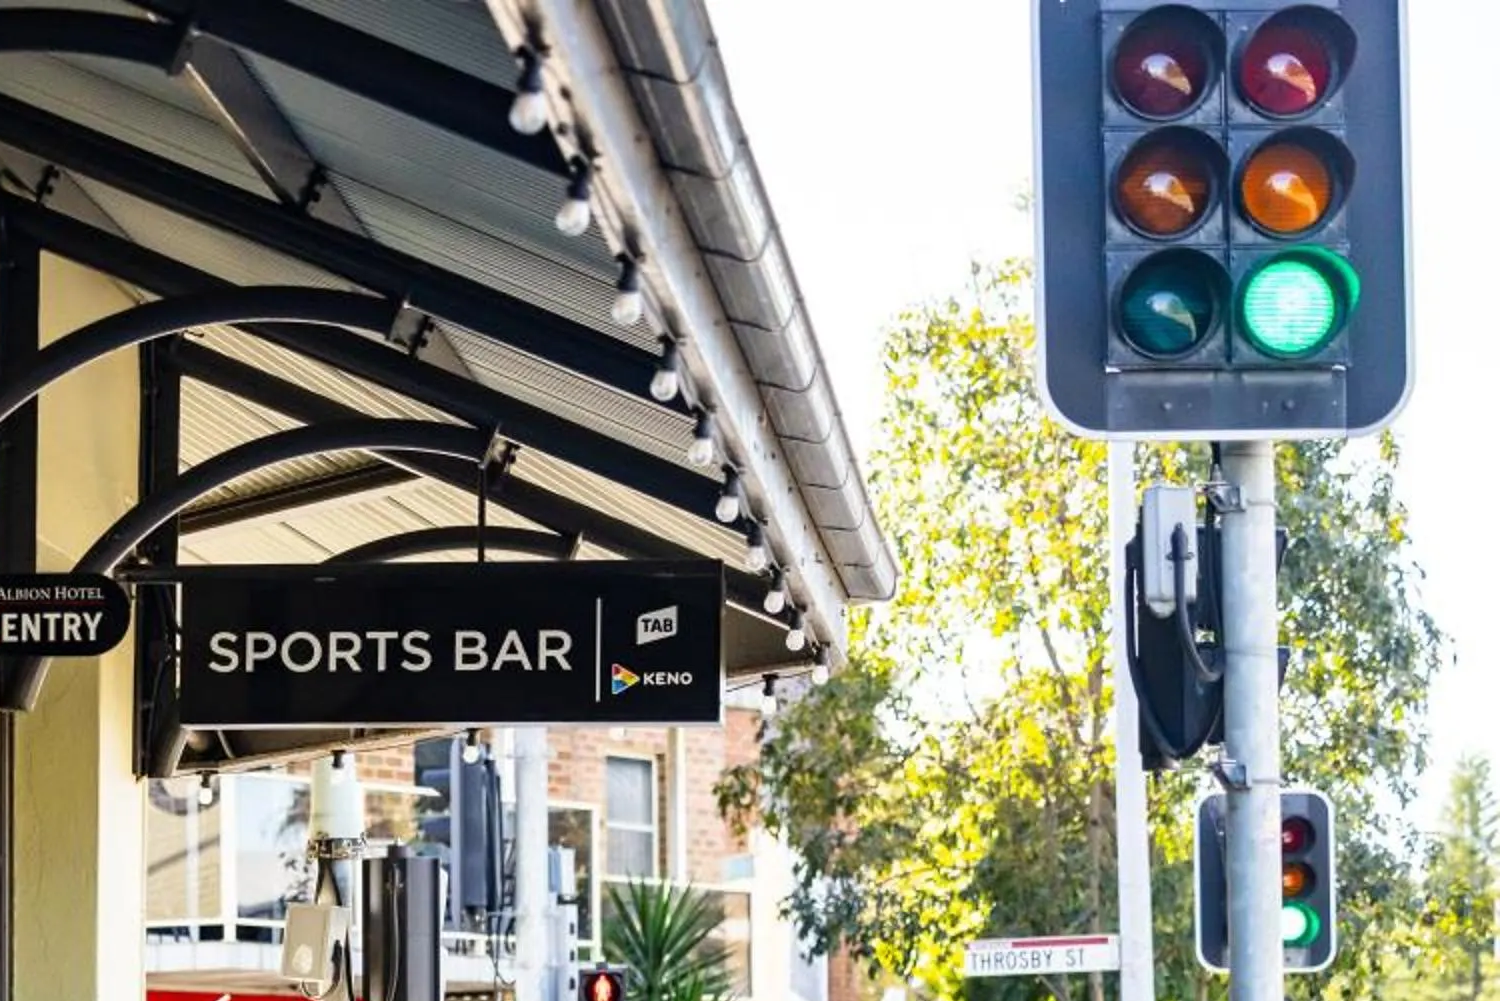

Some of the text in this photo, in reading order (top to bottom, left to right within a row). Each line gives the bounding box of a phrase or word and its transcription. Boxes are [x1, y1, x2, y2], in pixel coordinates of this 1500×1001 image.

[54, 586, 105, 600] HOTEL
[1, 611, 103, 643] ENTRY
[641, 618, 674, 633] TAB
[208, 629, 573, 673] SPORTS BAR
[643, 671, 693, 685] KENO
[971, 948, 1085, 971] THROSBY ST
